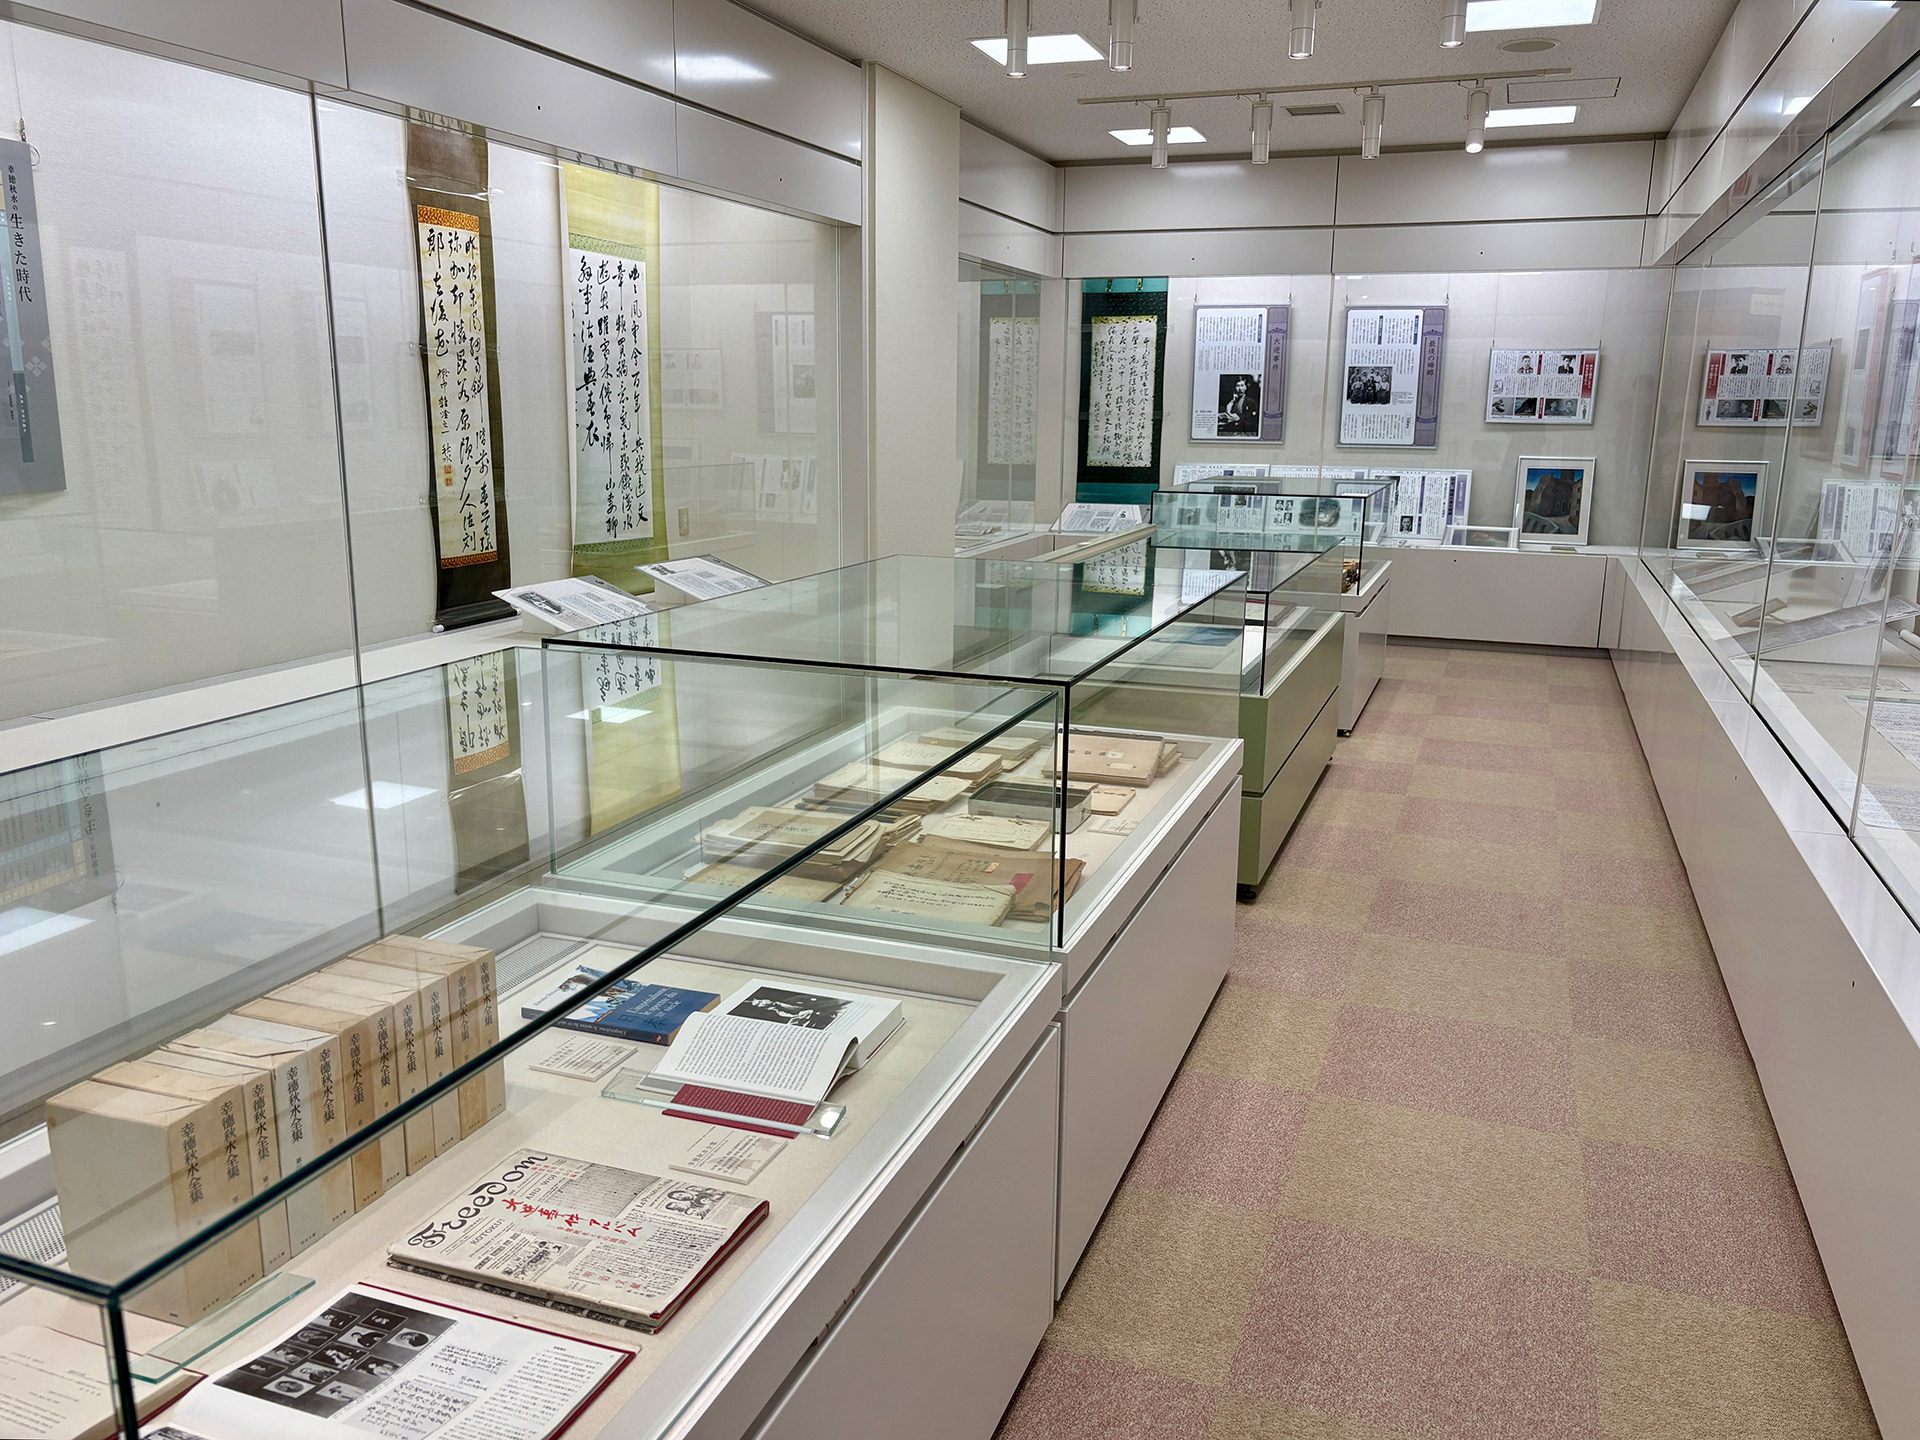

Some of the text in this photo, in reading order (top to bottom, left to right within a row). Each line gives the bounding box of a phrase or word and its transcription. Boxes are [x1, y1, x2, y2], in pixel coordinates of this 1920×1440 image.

[8, 165, 32, 303] 幸徳秋水の生きた時代
[1273, 338, 1281, 371] 大逆事件
[407, 1156, 548, 1248] Freedom
[502, 1197, 643, 1237] 大逆事件アルバム
